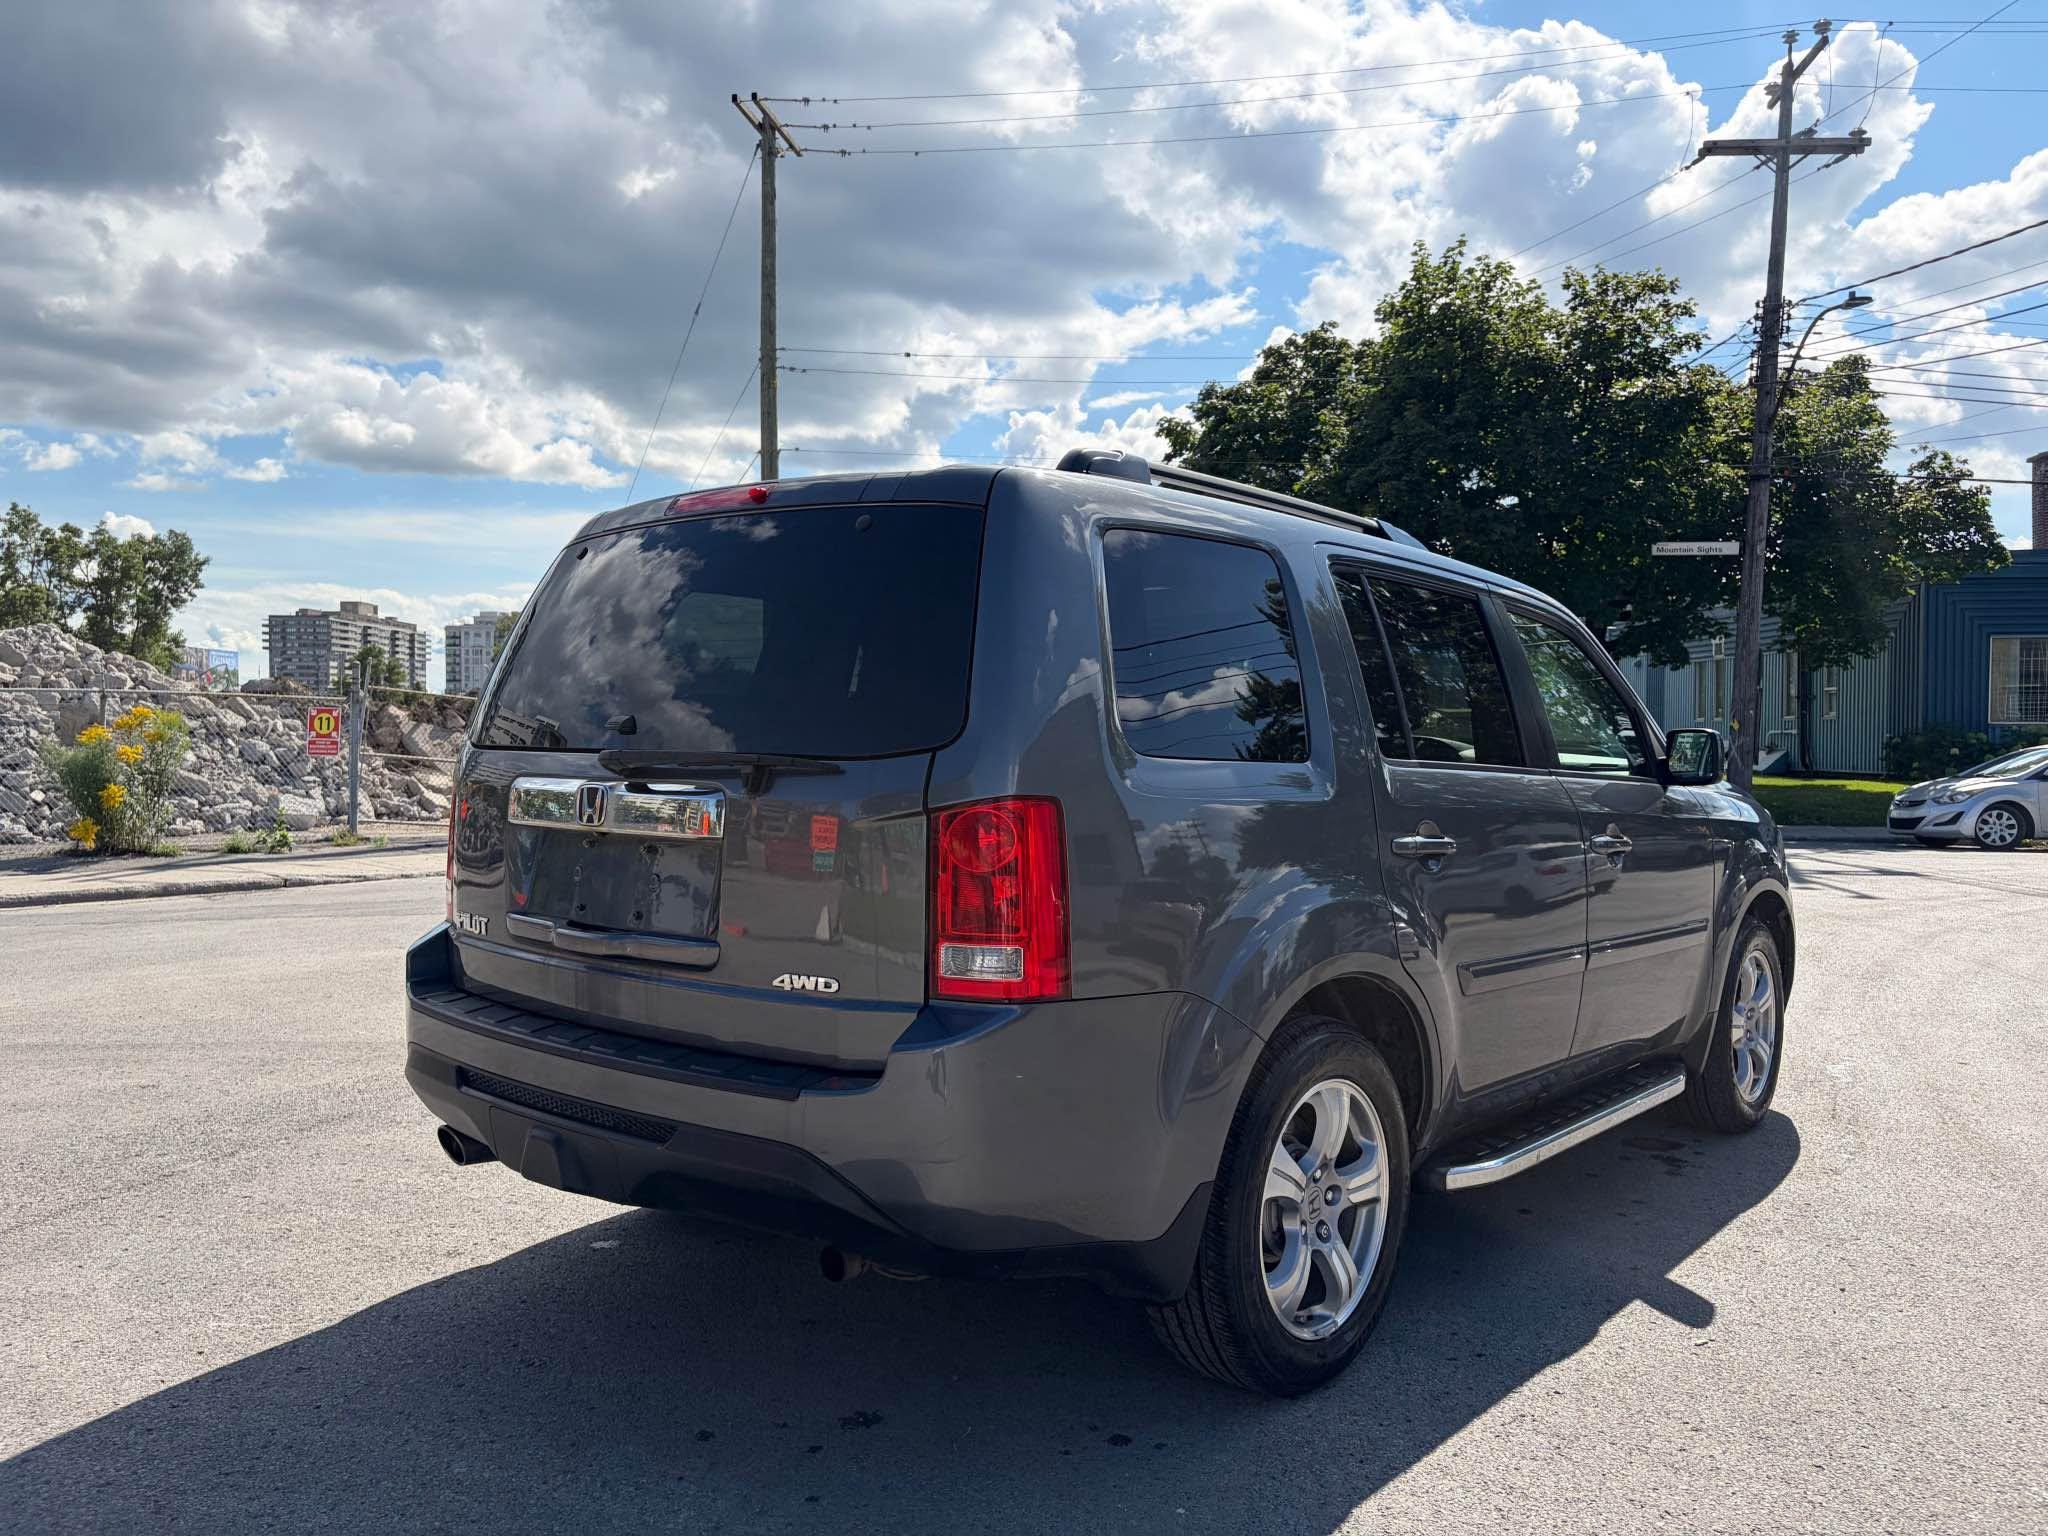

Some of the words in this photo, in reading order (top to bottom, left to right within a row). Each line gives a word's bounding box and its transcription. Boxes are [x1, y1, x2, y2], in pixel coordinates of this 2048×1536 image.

[1697, 545, 1723, 554] Sights
[317, 716, 331, 731] 11
[456, 911, 489, 936] PILOT
[772, 973, 840, 993] 4WD
